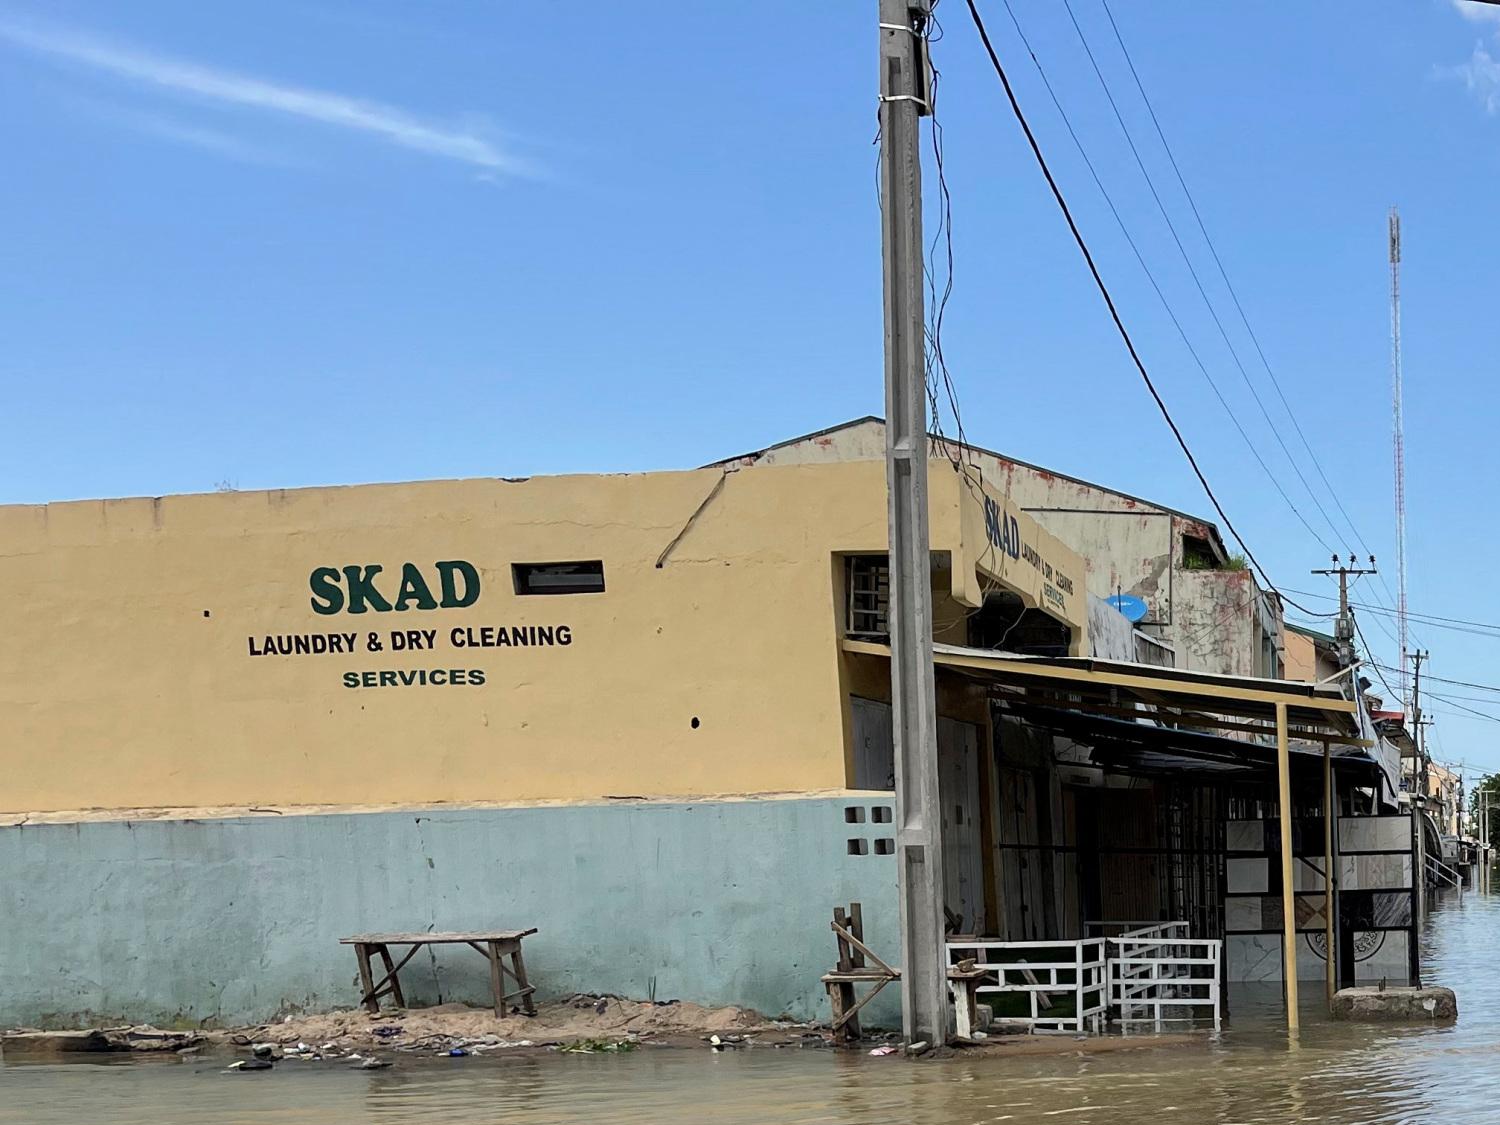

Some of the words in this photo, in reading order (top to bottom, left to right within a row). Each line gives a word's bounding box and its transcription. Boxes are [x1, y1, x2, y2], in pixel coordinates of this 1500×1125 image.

[984, 494, 1020, 561] SKAD
[309, 560, 481, 616] SKAD
[248, 632, 357, 656] LAUNDRY
[366, 632, 383, 652] &
[390, 629, 437, 651] DRY
[450, 625, 572, 648] CLEANING
[343, 669, 486, 688] SERVICES
